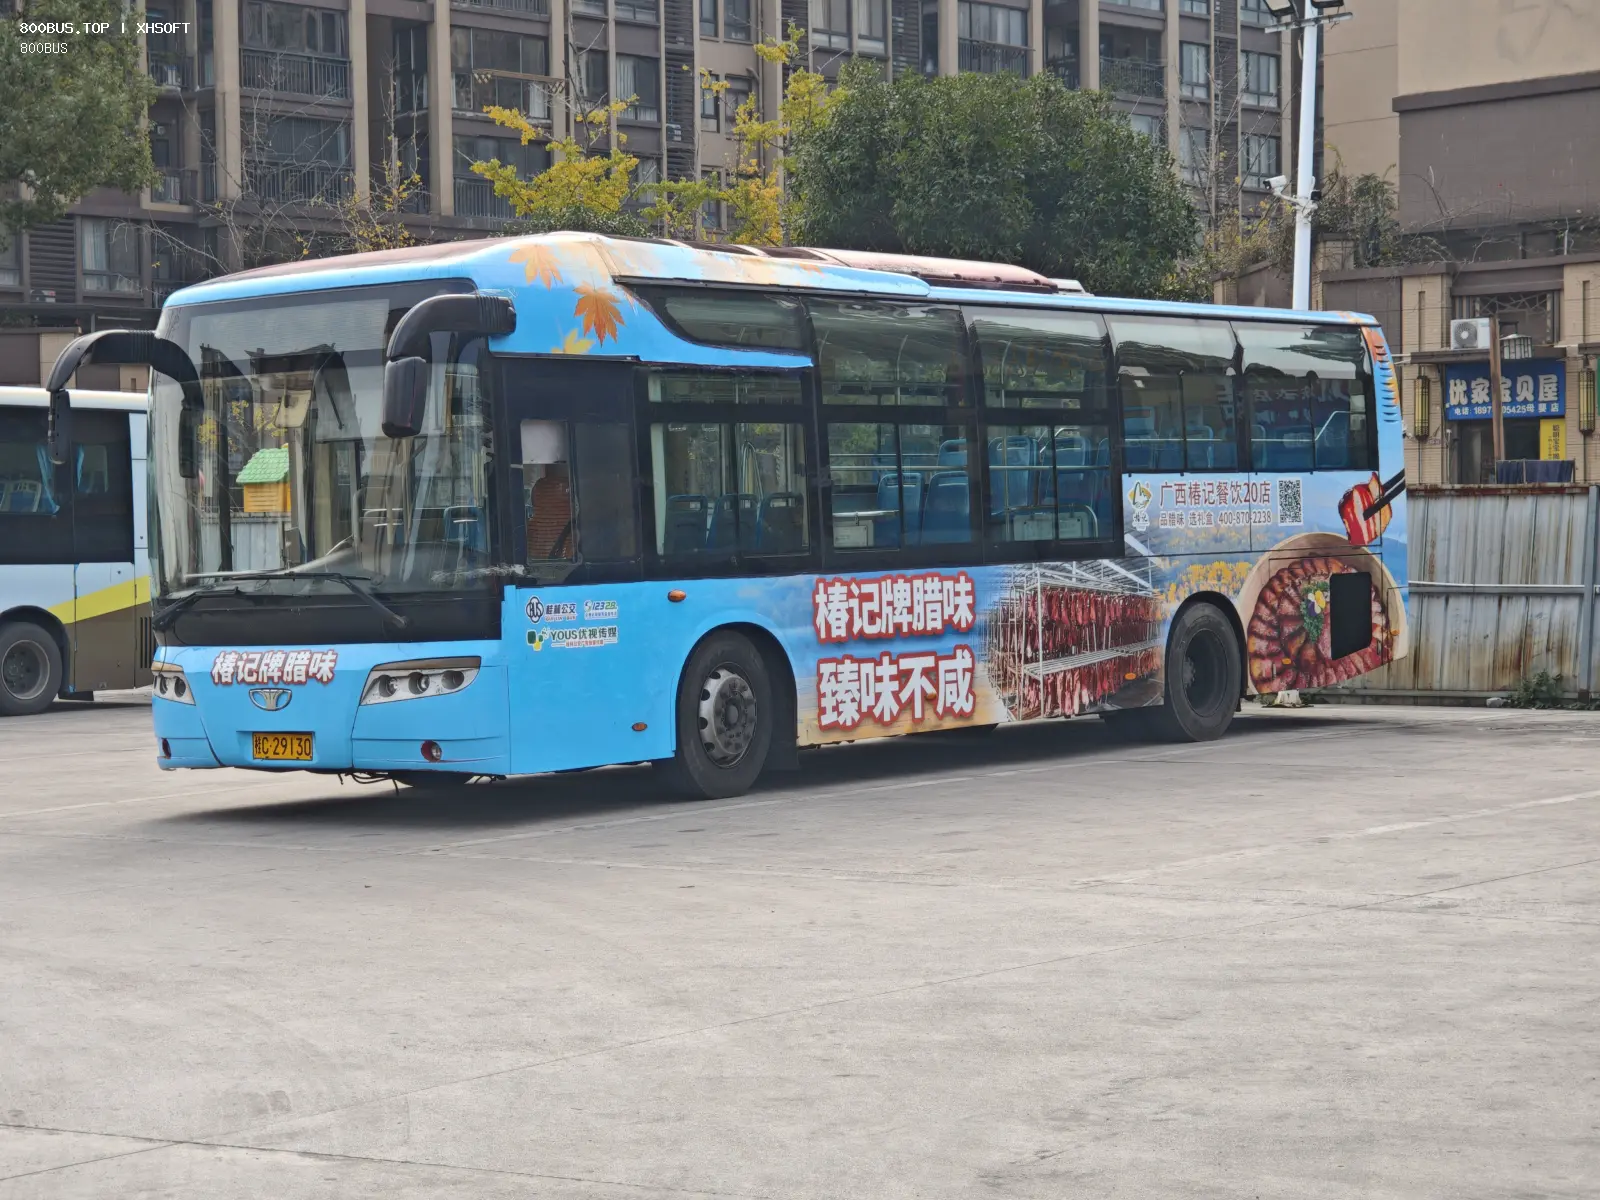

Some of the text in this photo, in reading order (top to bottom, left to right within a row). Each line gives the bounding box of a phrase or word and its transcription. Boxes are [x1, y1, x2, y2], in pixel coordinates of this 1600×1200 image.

[1474, 404, 1526, 415] 189705425
[1160, 481, 1271, 506] 广西椿记餐饮20店
[1219, 510, 1272, 525] 400-870-2238
[813, 573, 975, 642] 椿记牌腊味
[211, 650, 338, 685] 椿记牌腊味
[818, 647, 975, 729] 臻味不咸
